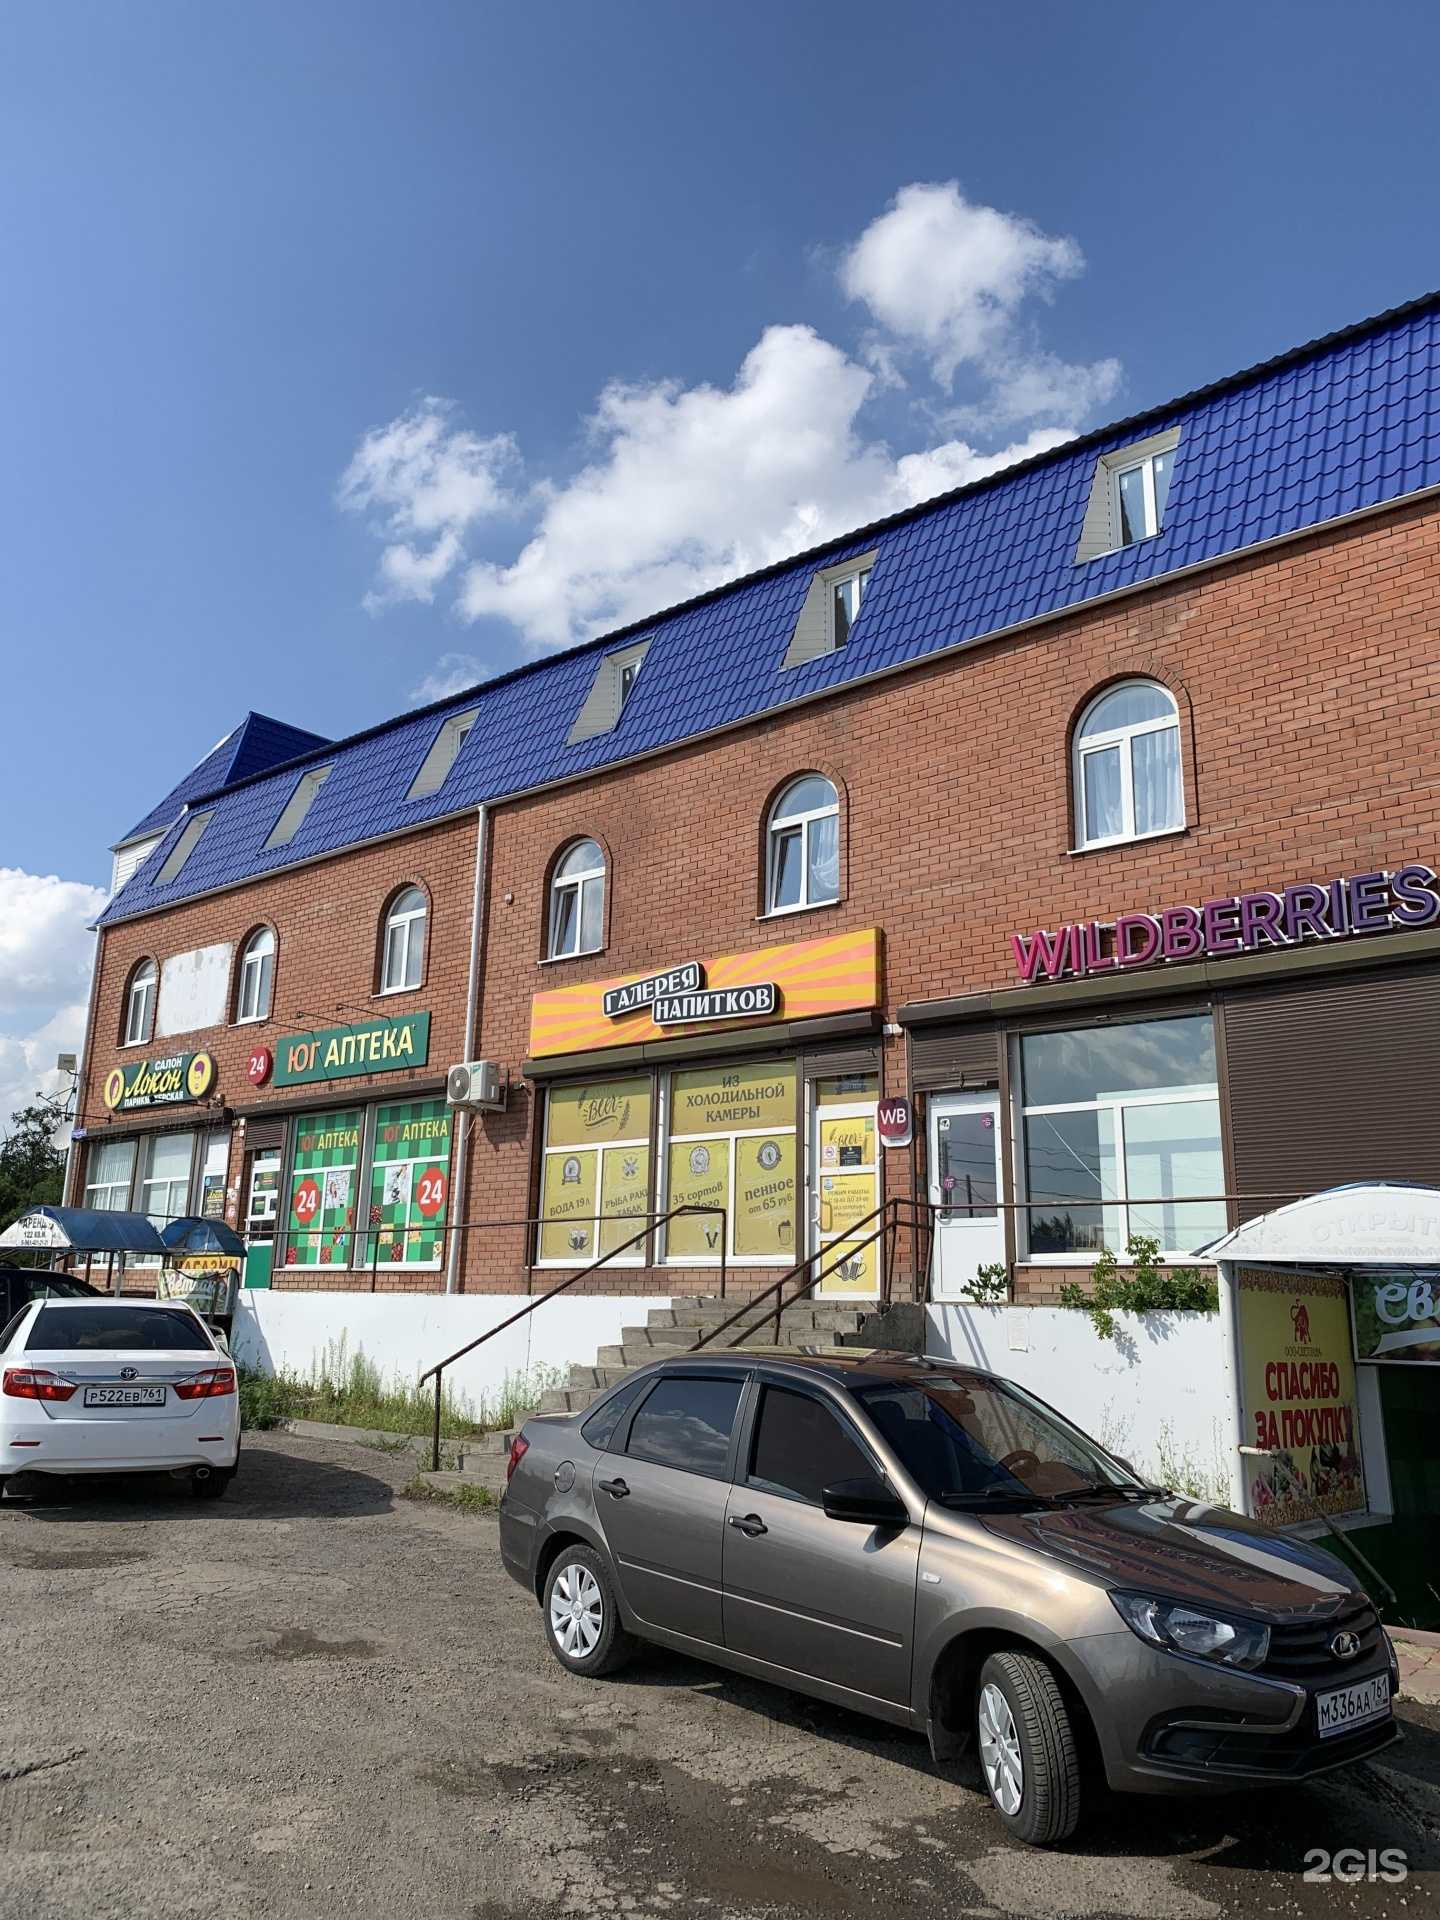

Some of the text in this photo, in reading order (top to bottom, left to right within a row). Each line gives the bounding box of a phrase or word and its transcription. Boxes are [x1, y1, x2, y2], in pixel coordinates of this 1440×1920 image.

[1011, 865, 1439, 982] WILDBERRIES
[605, 967, 695, 1012] ГАЛЕРЕЯ
[656, 988, 771, 1020] НАПИТКОВ
[288, 1026, 414, 1073] ЮГ АПТЕКА
[154, 1057, 183, 1071] САЛОН
[250, 1056, 265, 1075] 24
[125, 1061, 183, 1098] Локон
[721, 1075, 740, 1089] ИЗ
[686, 1083, 785, 1107] ХОЛОДИЛЬНОЙ
[706, 1106, 761, 1122] КАМЕРЫ
[880, 1108, 907, 1125] WB
[317, 1130, 359, 1150] АПТЕКА
[402, 1120, 448, 1141] АПТЕКА
[420, 1180, 443, 1205] 24
[605, 1193, 628, 1209] РЫБА
[673, 1181, 724, 1206] 35 сортов
[745, 1178, 794, 1201] пенное
[297, 1190, 316, 1213] 24
[550, 1200, 575, 1216] ВОДА
[763, 1198, 777, 1211] 65
[1265, 1361, 1340, 1401] СПАСИБО
[143, 1388, 161, 1399] 761
[1254, 1411, 1280, 1450] ЗА
[1371, 1677, 1388, 1701] 761
